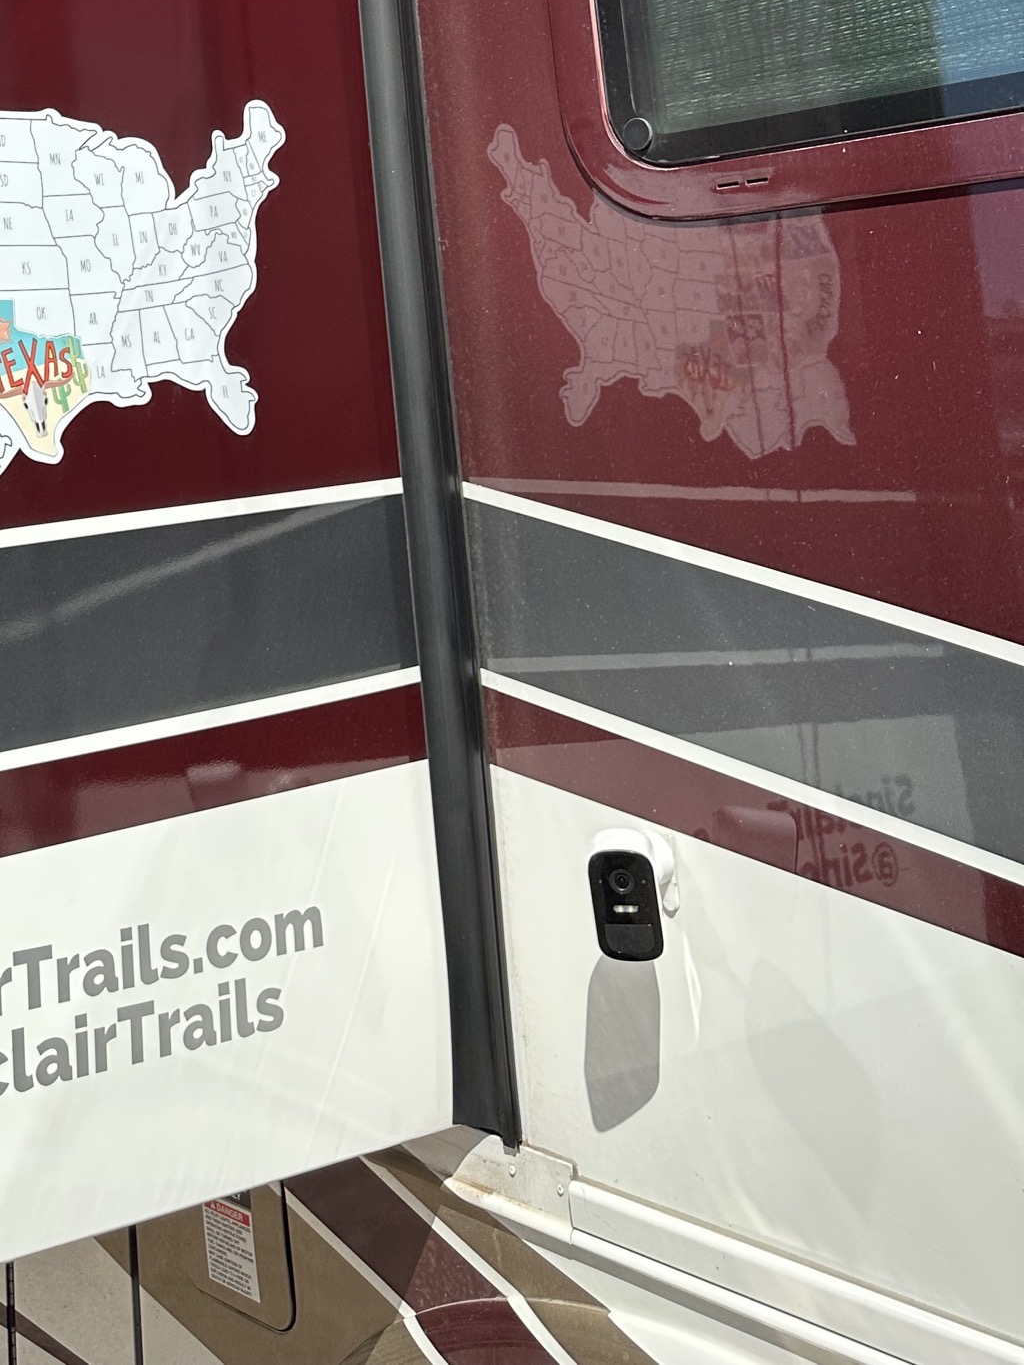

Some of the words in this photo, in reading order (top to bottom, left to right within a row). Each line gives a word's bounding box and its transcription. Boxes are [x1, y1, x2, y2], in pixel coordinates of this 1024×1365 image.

[49, 152, 61, 166] MN
[0, 174, 9, 188] SD
[65, 209, 74, 222] IA
[209, 205, 218, 218] PA
[3, 217, 13, 230] NE
[218, 250, 228, 263] VA
[21, 261, 31, 275] KS
[80, 259, 91, 272] MO
[158, 264, 167, 277] KY
[214, 279, 224, 292] NC
[144, 290, 154, 303] TN
[36, 306, 47, 320] OK
[89, 312, 98, 325] AR
[208, 306, 217, 320] SC
[153, 331, 161, 344] AL
[185, 328, 195, 341] GA
[121, 335, 132, 348] MS
[96, 365, 106, 379] LA
[216, 1202, 244, 1223] DANGER
